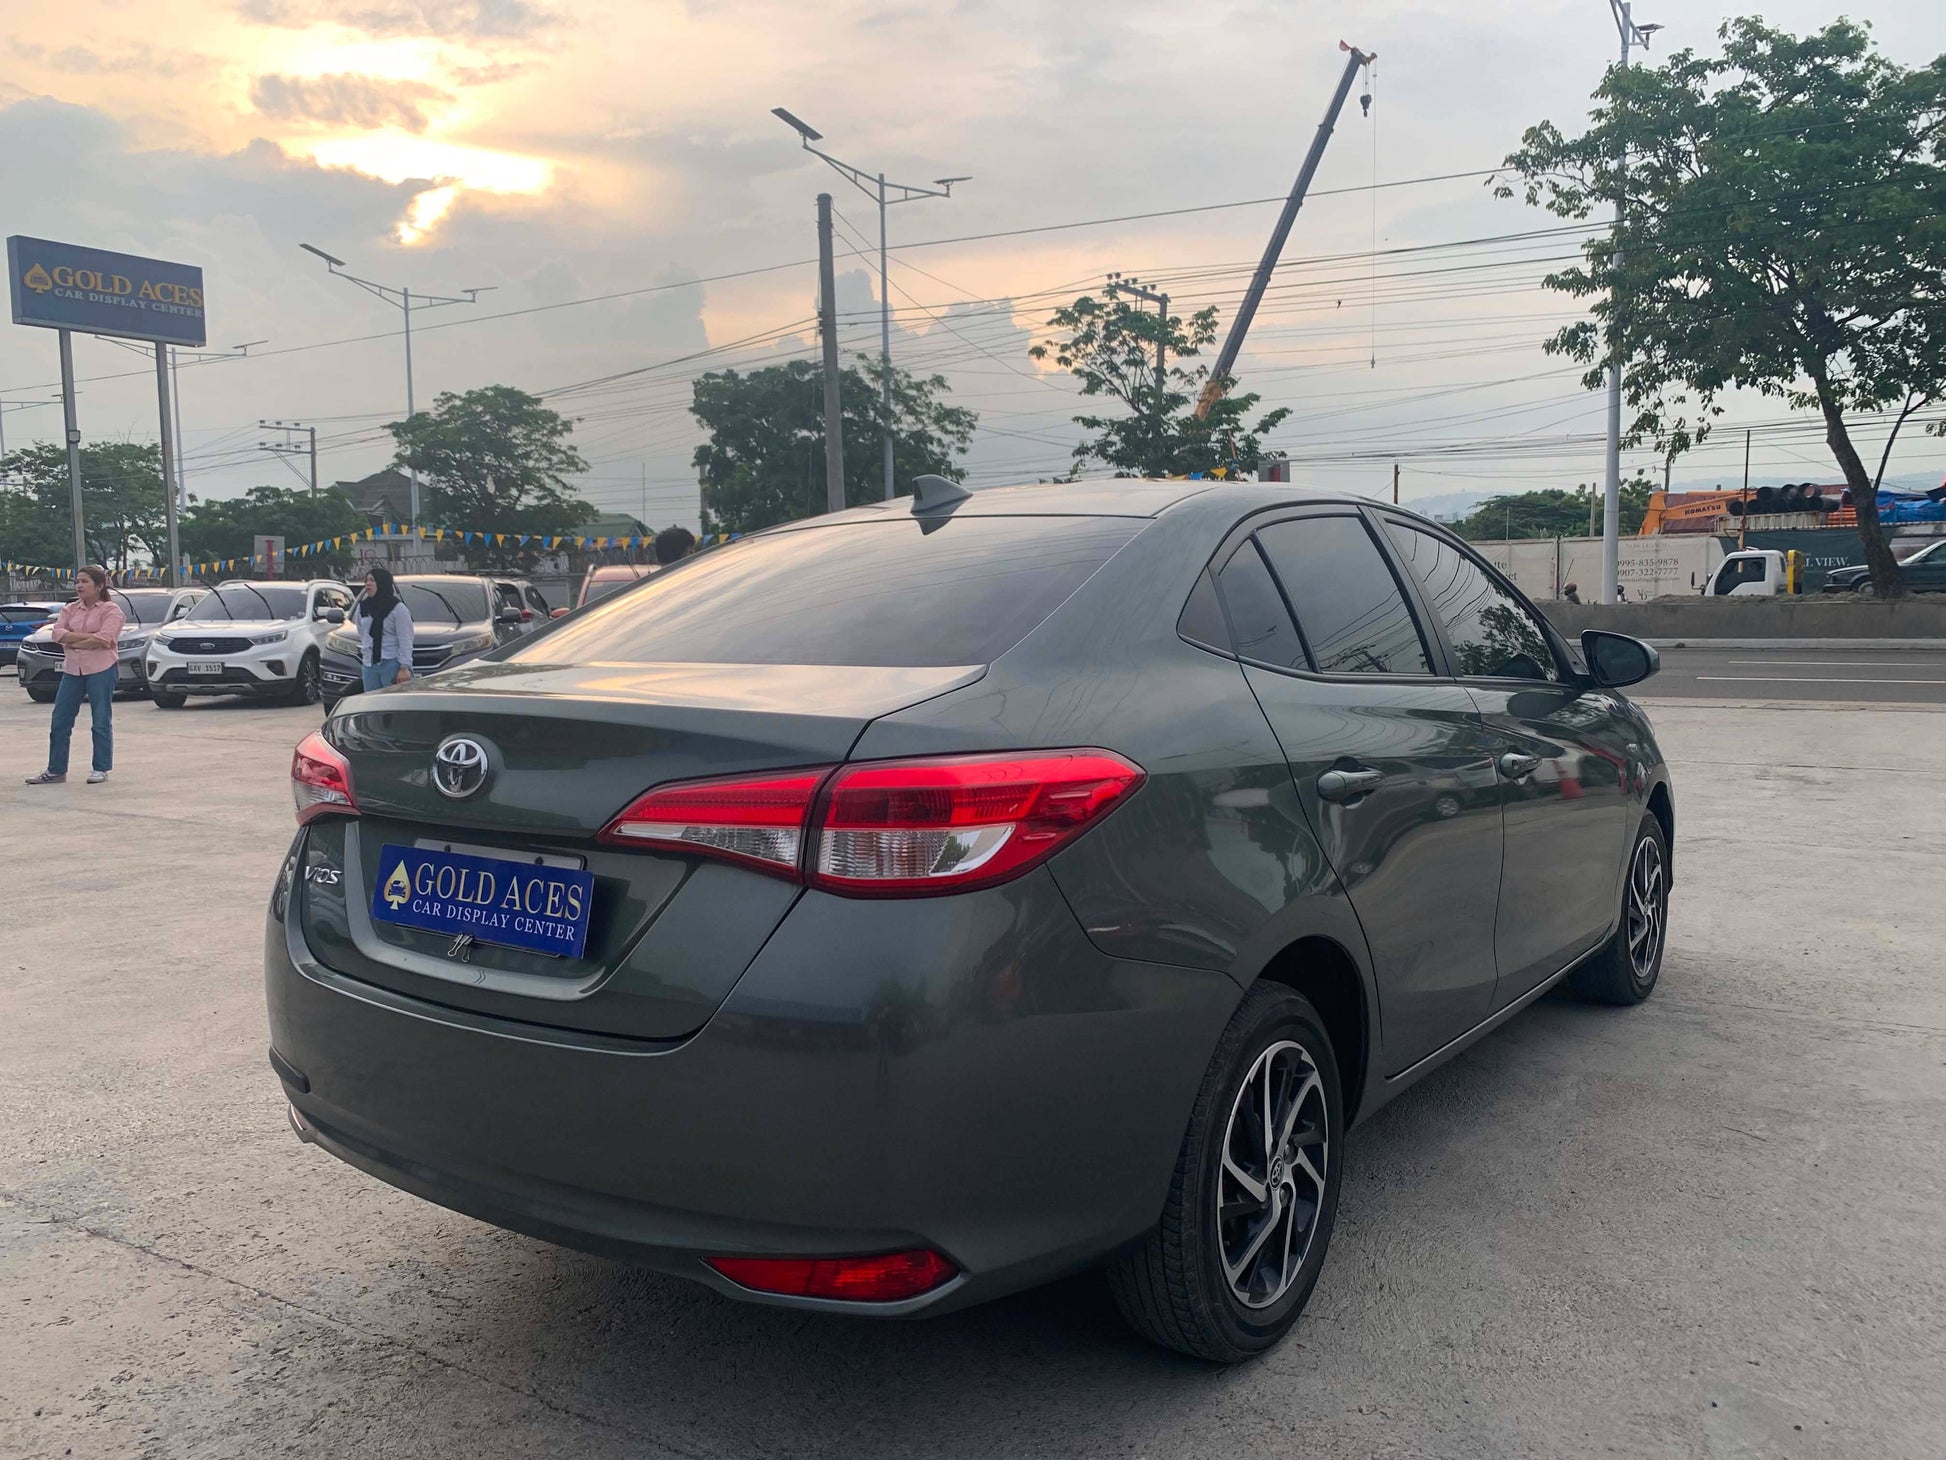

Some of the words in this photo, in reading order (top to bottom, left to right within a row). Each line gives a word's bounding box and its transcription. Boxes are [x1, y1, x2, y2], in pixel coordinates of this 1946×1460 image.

[52, 266, 132, 295] GOLD
[138, 279, 204, 307] ACES
[54, 287, 84, 300] CAR
[88, 292, 147, 309] DISPLAY
[152, 303, 204, 318] CENTER
[1684, 504, 1721, 515] KOMATSU
[415, 862, 496, 905] GOLD
[500, 875, 583, 920] ACES
[412, 899, 441, 917] CAR
[446, 905, 510, 928] DISPLAY
[514, 916, 575, 941] CENTER
